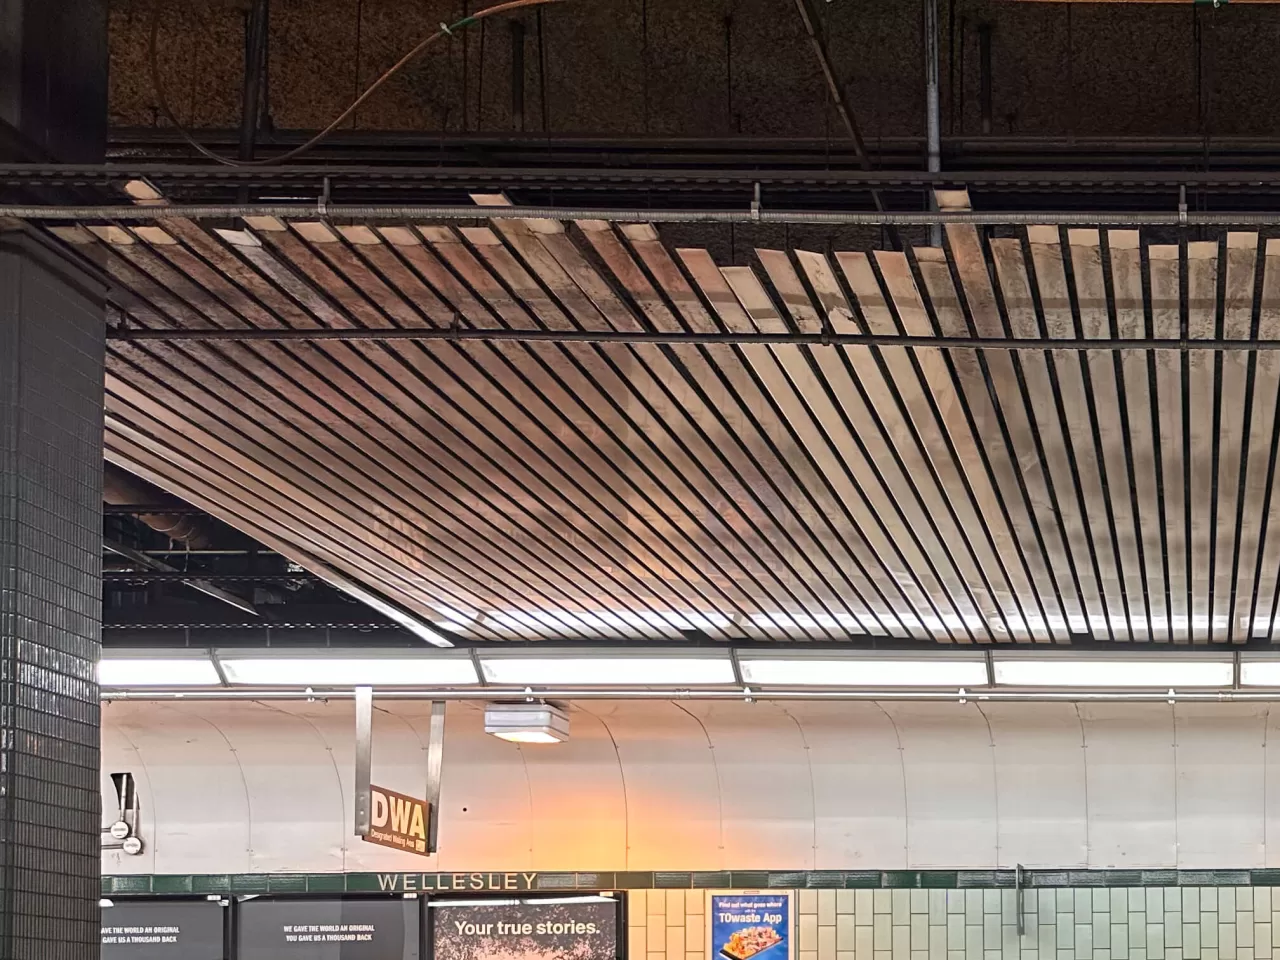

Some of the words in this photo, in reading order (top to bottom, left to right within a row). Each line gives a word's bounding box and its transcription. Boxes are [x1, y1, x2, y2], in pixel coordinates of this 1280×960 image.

[371, 790, 426, 840] DWA
[377, 872, 538, 891] WELLESLEY
[719, 912, 761, 923] TOwaste
[762, 912, 782, 924] App
[101, 926, 112, 934] AVE
[112, 926, 123, 934] THE
[124, 926, 144, 934] WORLD
[320, 924, 340, 932] WORLD
[454, 920, 494, 935] Your
[497, 920, 533, 935] true
[536, 919, 601, 935] stories.
[161, 935, 177, 943] BACK
[356, 933, 373, 941] BACK
